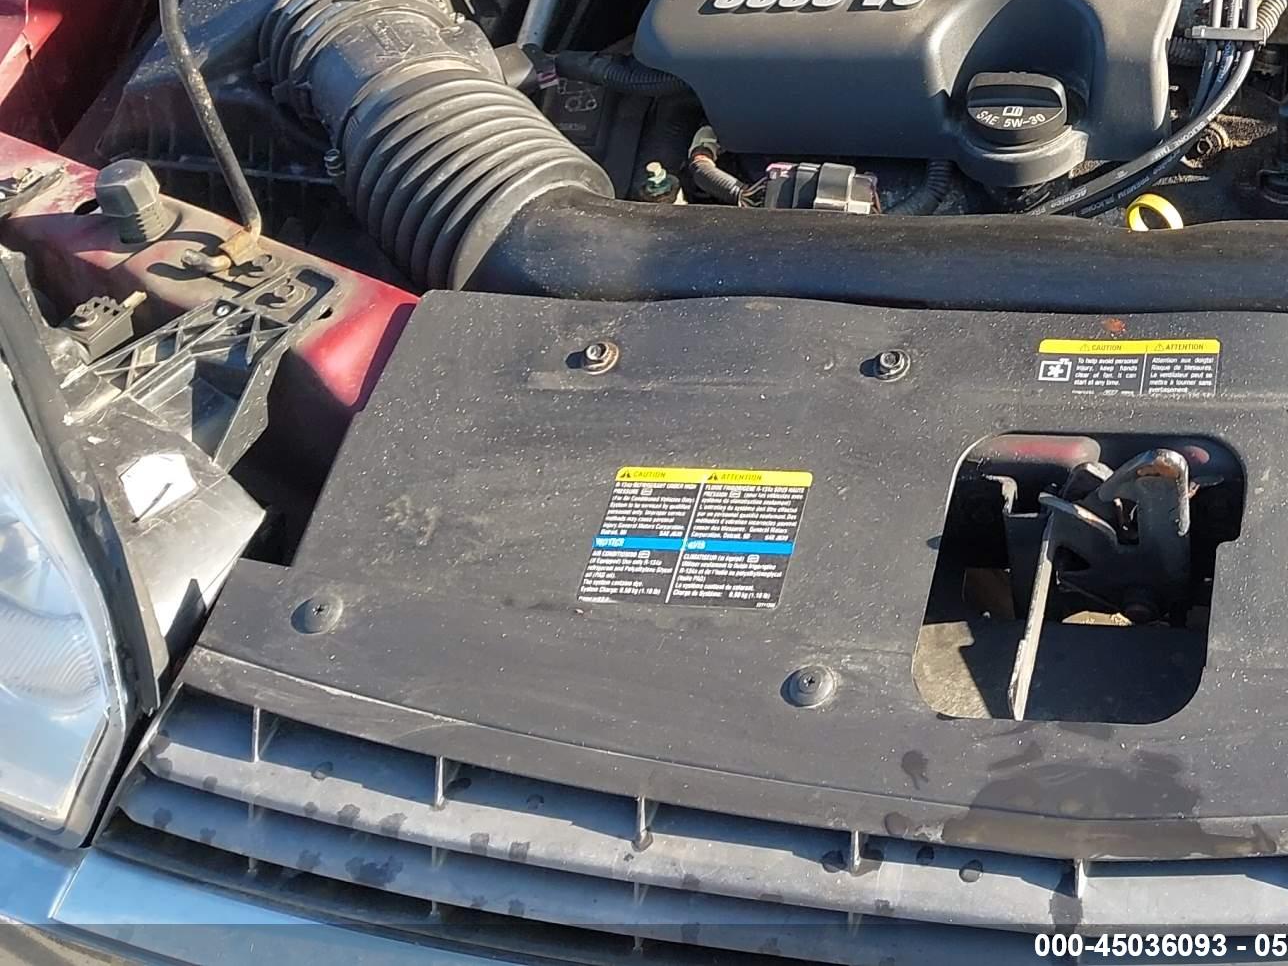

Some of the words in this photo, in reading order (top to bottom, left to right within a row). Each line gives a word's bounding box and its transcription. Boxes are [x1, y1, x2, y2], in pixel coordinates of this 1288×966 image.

[976, 110, 1000, 125] SAE
[1003, 113, 1046, 128] 5W-30
[633, 470, 667, 478] CAUTION
